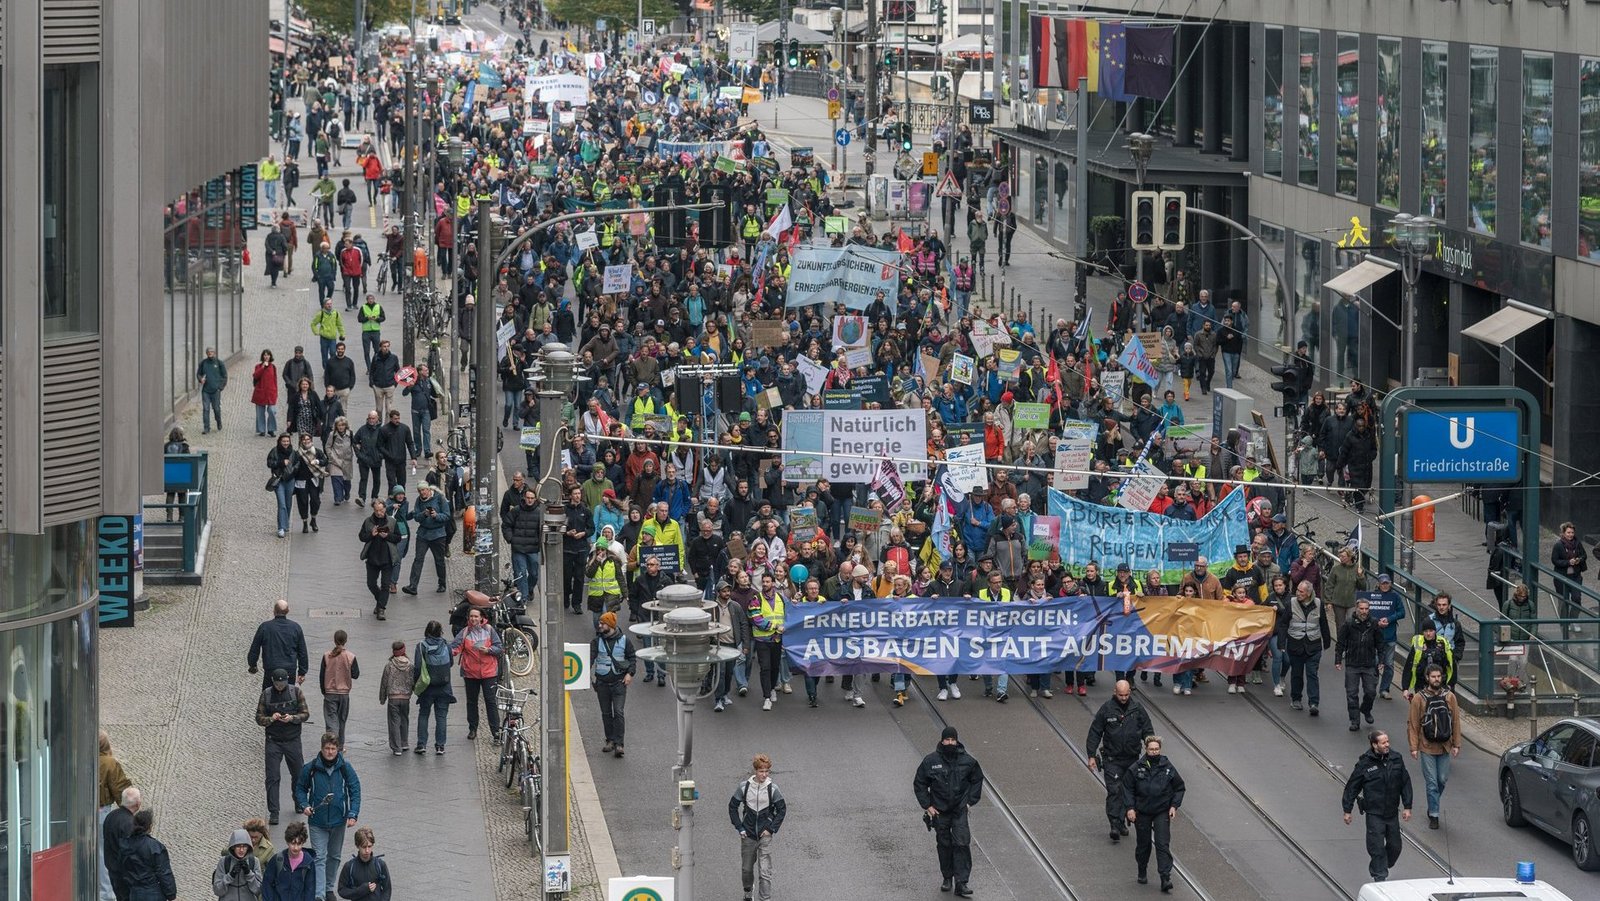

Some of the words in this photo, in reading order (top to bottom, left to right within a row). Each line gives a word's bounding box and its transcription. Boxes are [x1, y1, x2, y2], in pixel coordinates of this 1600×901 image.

[241, 166, 256, 229] WEEKDAY
[831, 416, 917, 433] Natürlich
[1449, 416, 1475, 450] U
[830, 437, 902, 457] Energie
[830, 459, 927, 479] gewien.
[1413, 459, 1510, 473] Friedrichstraße
[803, 609, 959, 629] ERNEUERBARE
[966, 609, 1078, 627] ENERGIEN:
[803, 636, 960, 660] AUSBAUEN
[968, 636, 1053, 659] STATT
[1060, 633, 1256, 662] AUSBREMSEN!
